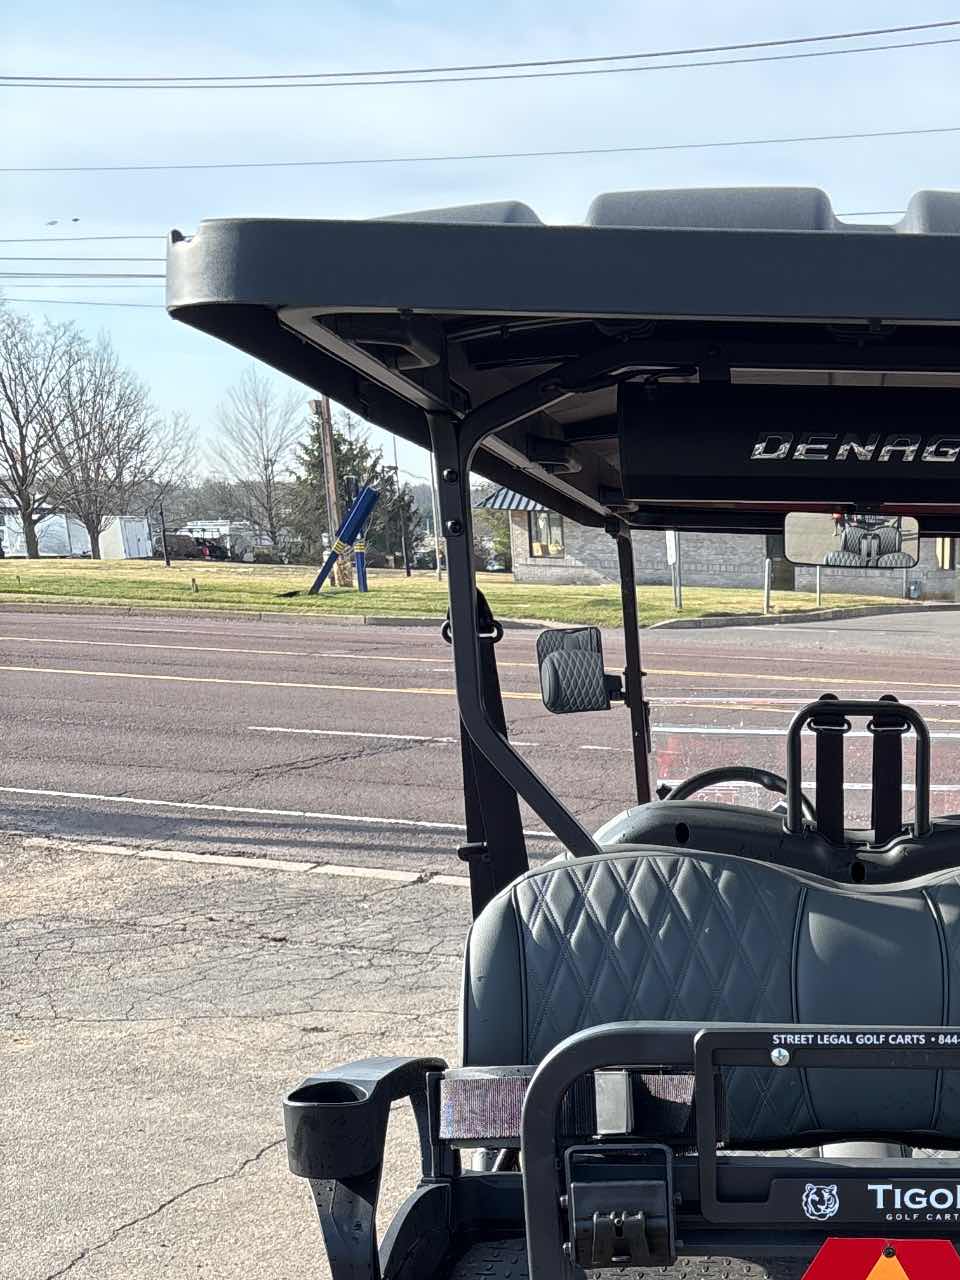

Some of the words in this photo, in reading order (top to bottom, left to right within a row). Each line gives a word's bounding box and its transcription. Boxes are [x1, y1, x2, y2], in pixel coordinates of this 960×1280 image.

[772, 1034, 815, 1045] STREET
[817, 1034, 853, 1045] LEGAL
[855, 1034, 886, 1045] GOLF
[888, 1034, 926, 1045] CARTS
[886, 1213, 919, 1221] GOLF
